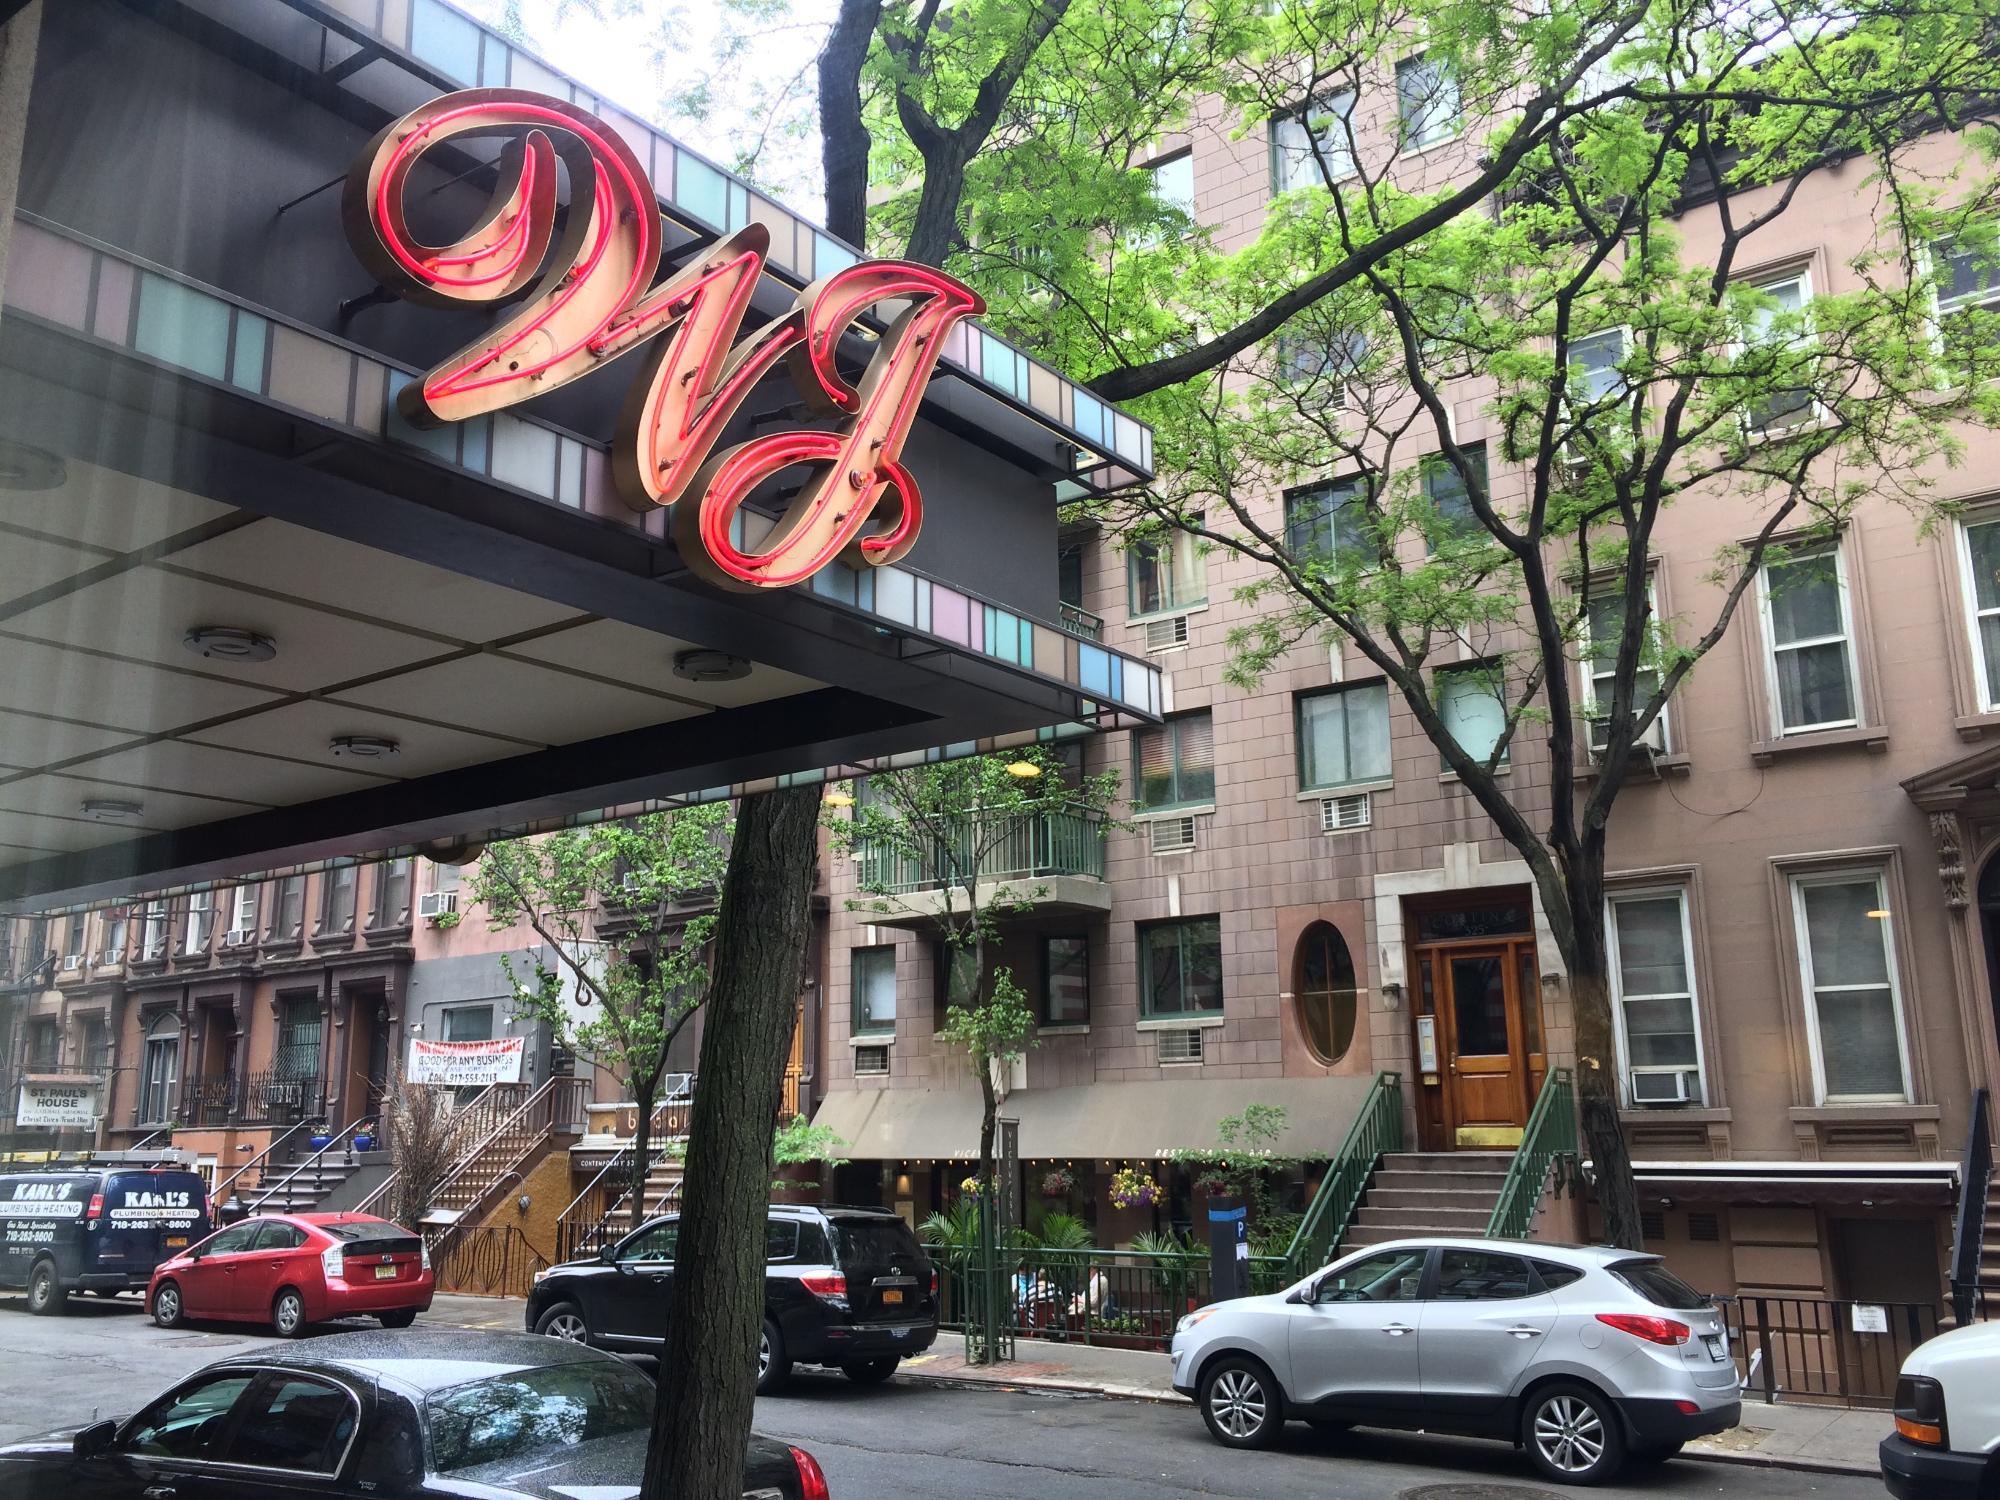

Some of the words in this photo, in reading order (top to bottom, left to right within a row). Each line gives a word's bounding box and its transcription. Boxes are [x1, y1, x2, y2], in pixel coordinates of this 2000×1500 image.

[419, 1056, 441, 1066] GOOD
[443, 1056, 457, 1065] FOR
[459, 1055, 474, 1065] ANY
[476, 1054, 512, 1066] BUSINESS
[31, 1088, 46, 1097] ST.
[49, 1087, 88, 1098] PAUL'S
[37, 1099, 79, 1108] HOUSE
[12, 1182, 72, 1200] KARL'S
[124, 1191, 189, 1207] KARL'S
[43, 1204, 79, 1213] HEATING
[7, 1220, 17, 1229] Gas
[1238, 1221, 1244, 1237] P
